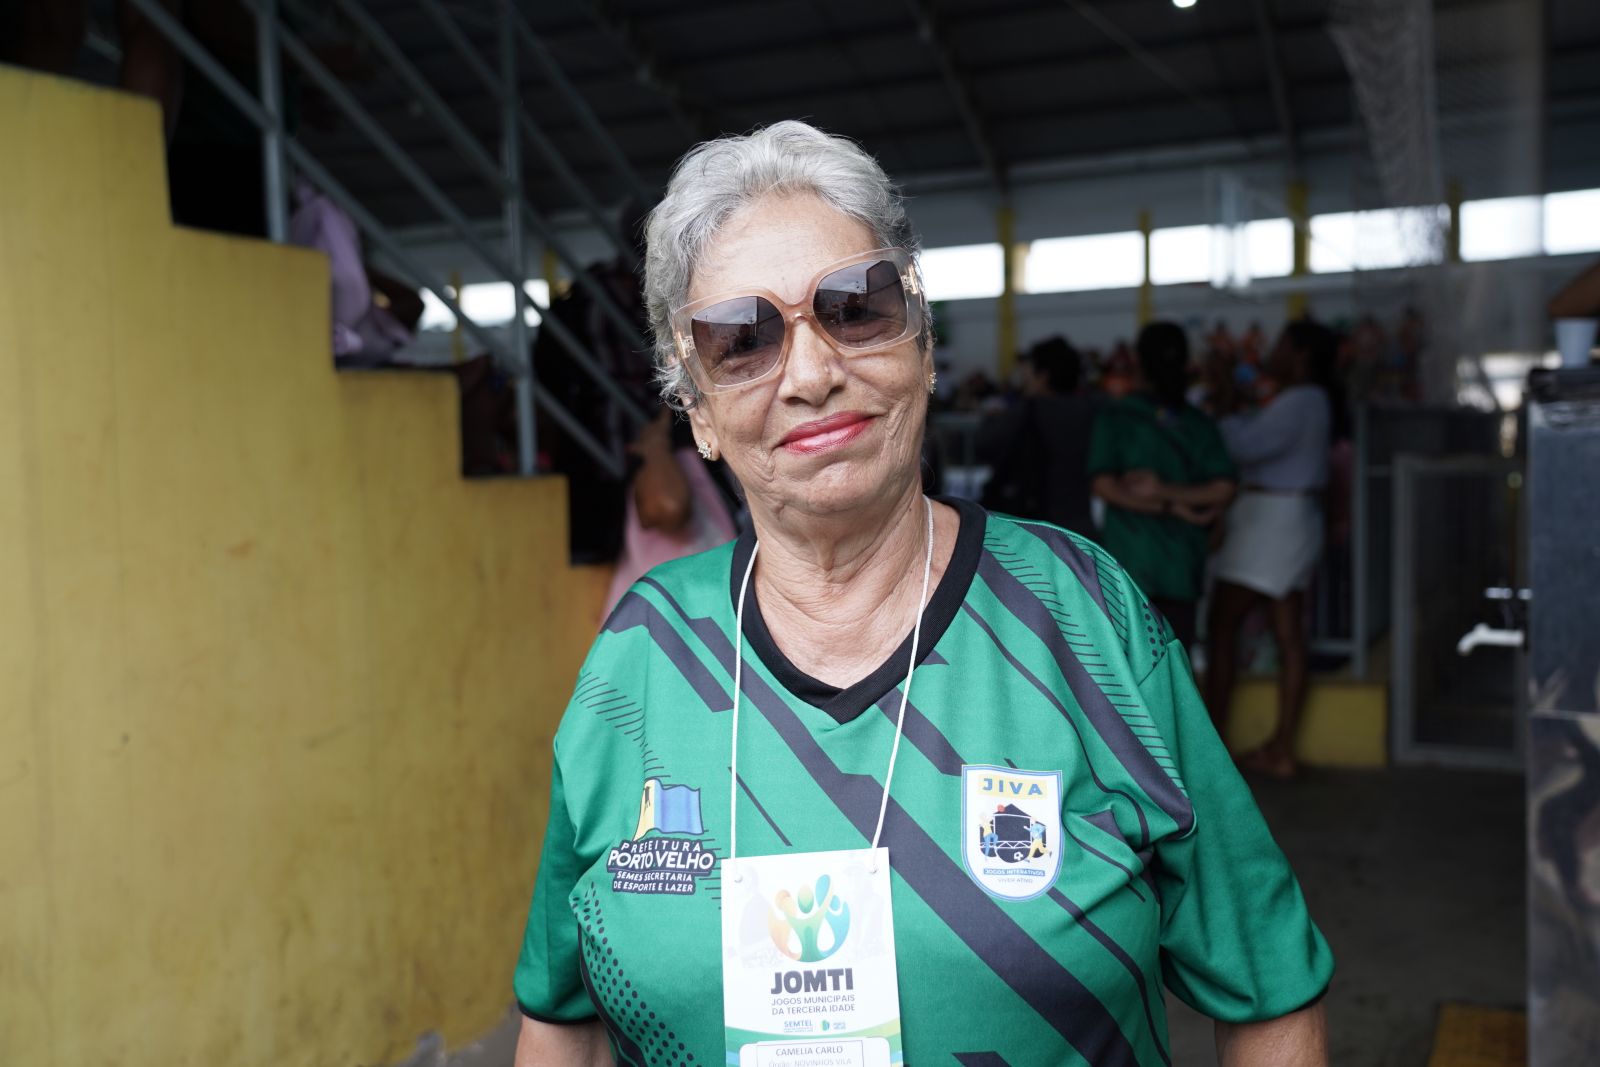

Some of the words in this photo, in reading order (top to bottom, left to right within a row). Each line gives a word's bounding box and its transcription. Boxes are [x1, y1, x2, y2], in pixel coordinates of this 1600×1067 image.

[982, 778, 1043, 795] JIVA
[621, 840, 701, 853] PREFEITURA
[608, 850, 653, 869] PORTO
[655, 851, 714, 869] VELHO
[617, 870, 643, 881] SEMES
[644, 872, 692, 882] SECRETARIA
[613, 881, 622, 889] DE
[623, 881, 656, 891] ESPORTE
[658, 883, 663, 891] E
[665, 883, 694, 892] LAZER
[770, 968, 854, 994] JOMTI
[771, 997, 802, 1006] JOGOS
[803, 994, 855, 1005] MUNICIPAIS
[771, 1007, 784, 1015] DA
[787, 1006, 827, 1015] TERCEIRA
[829, 1004, 855, 1012] IDADE
[784, 1019, 813, 1028] SEMTEL
[775, 1047, 813, 1056] CAMELIA
[815, 1046, 843, 1054] CARLO
